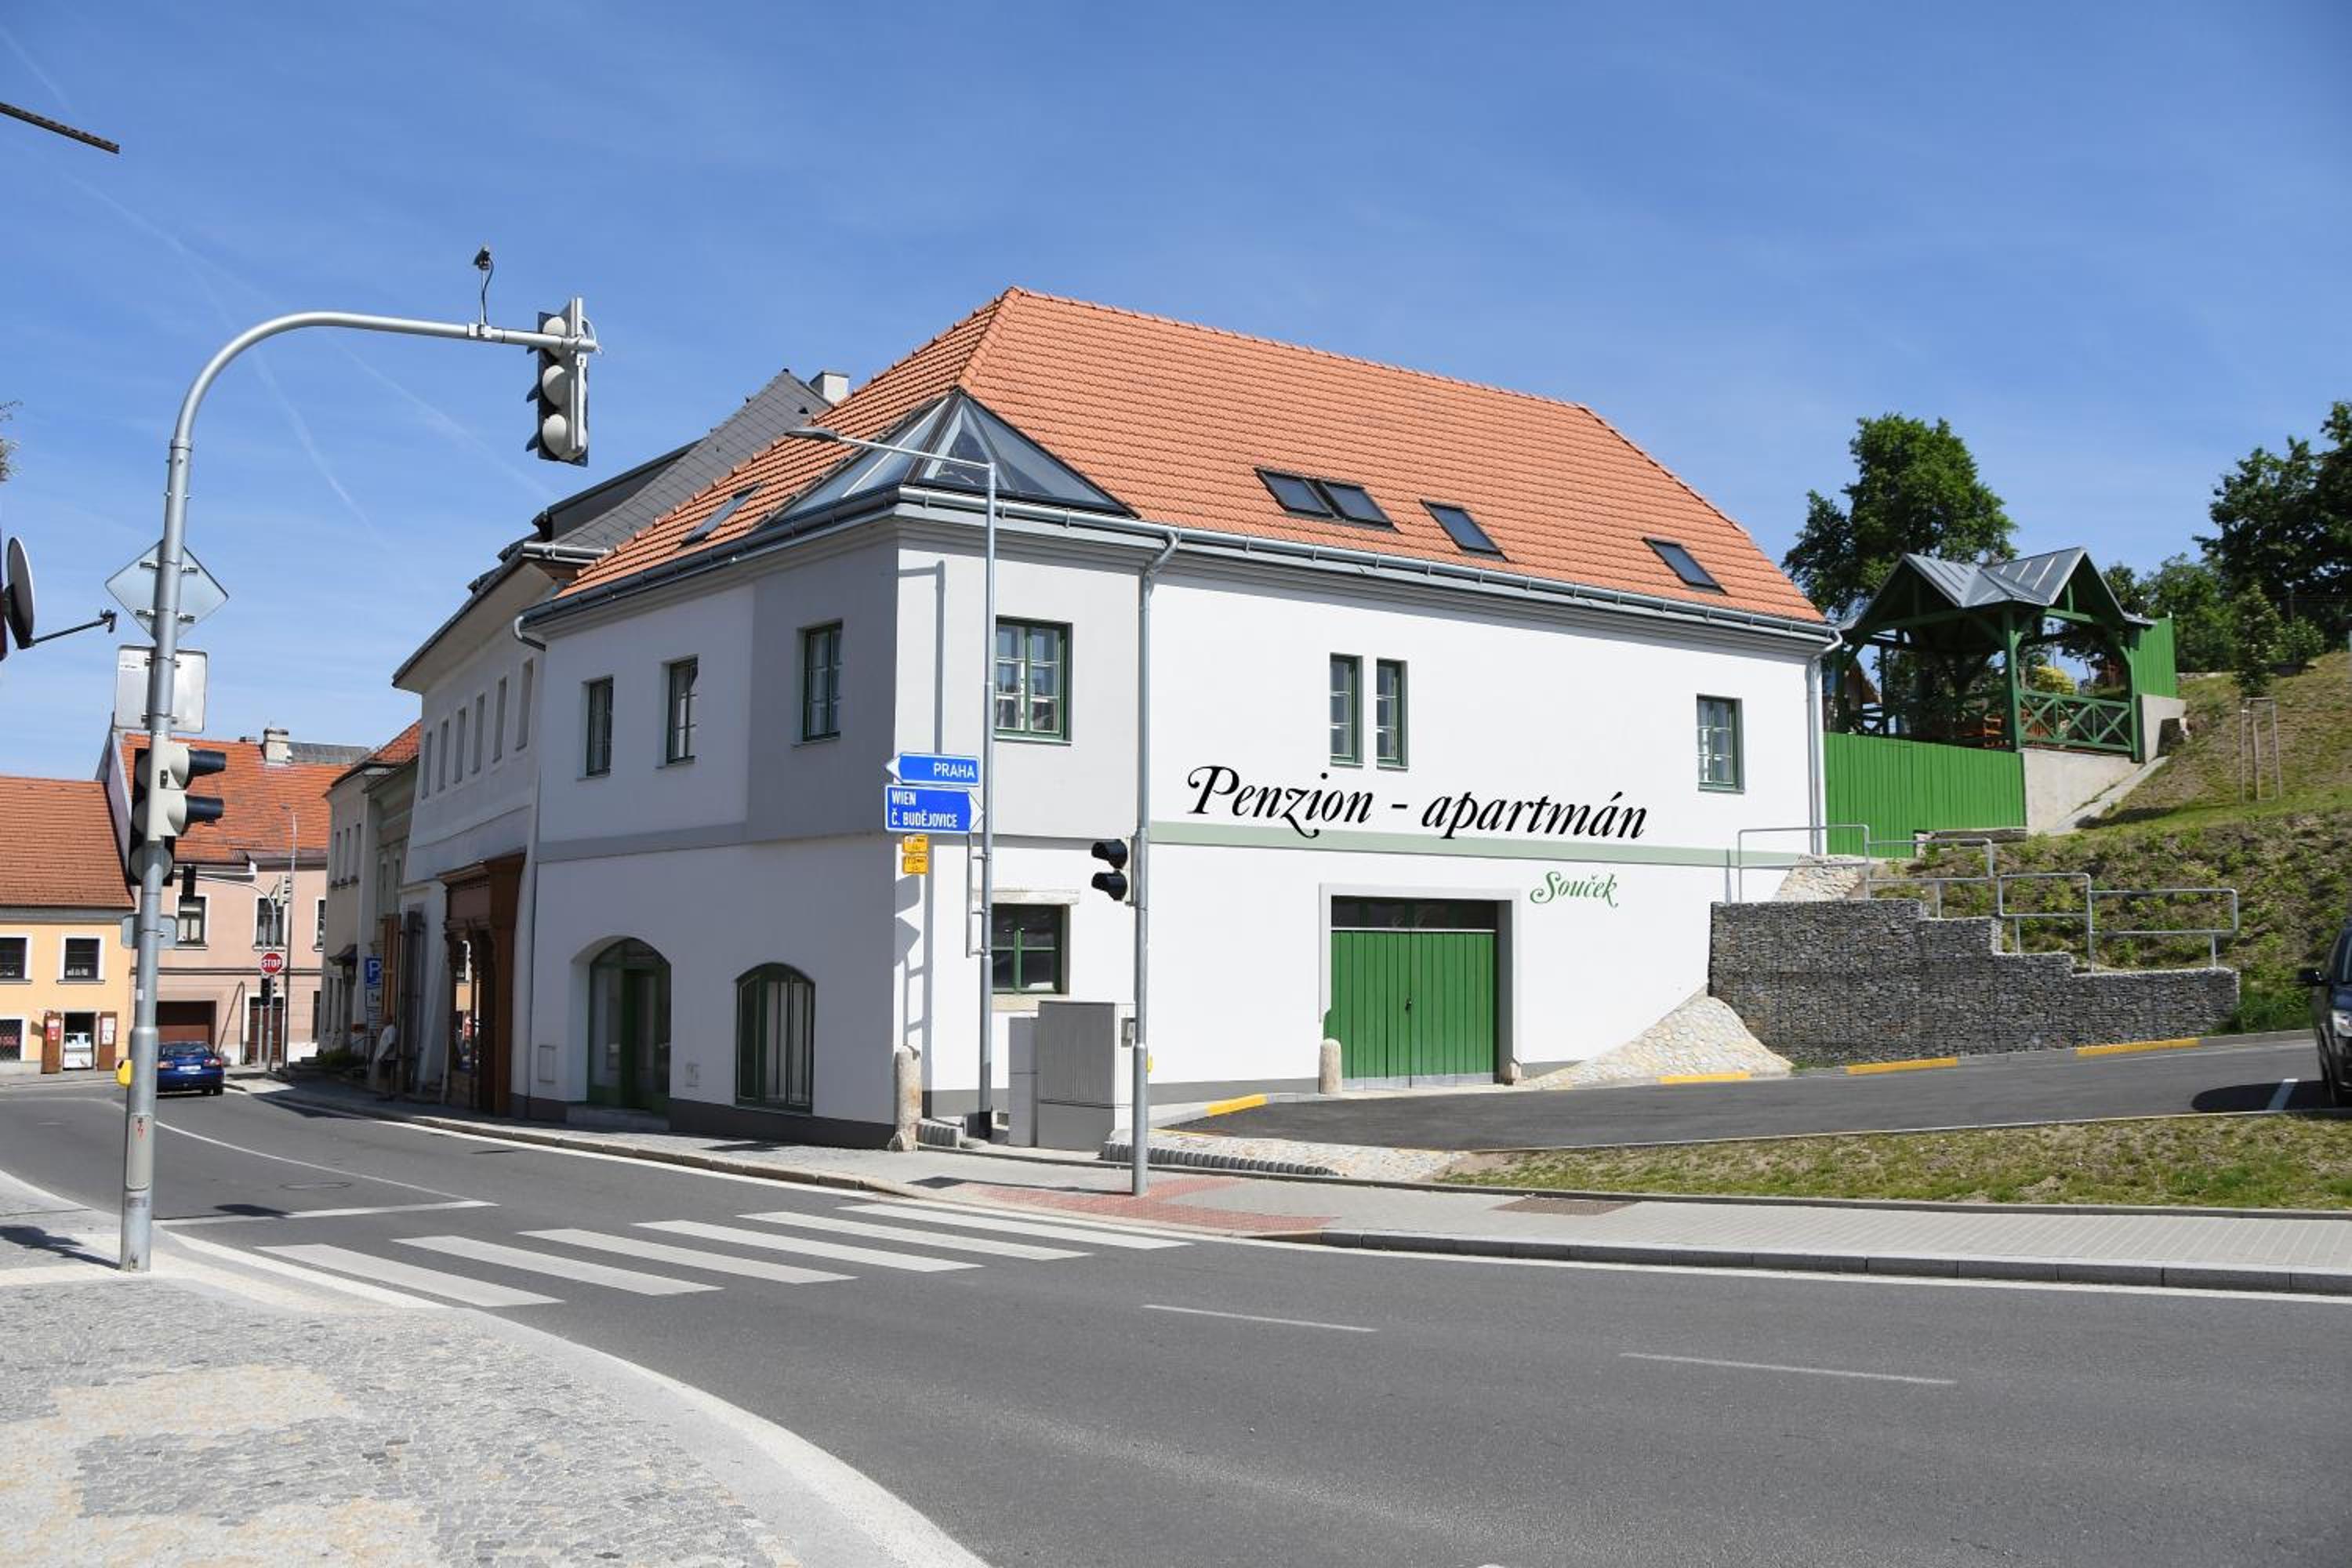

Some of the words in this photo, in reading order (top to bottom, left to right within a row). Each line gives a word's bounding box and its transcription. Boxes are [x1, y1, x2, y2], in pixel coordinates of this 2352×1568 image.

[933, 762, 975, 779] PRAHA
[891, 789, 917, 806] WIEN
[1187, 765, 1374, 840] Penzion
[1421, 791, 1648, 840] apartmán
[891, 808, 901, 826] Č.
[902, 809, 958, 829] BUDĚJOVICE
[1529, 871, 1619, 908] Souček
[262, 958, 281, 968] STOP
[368, 960, 382, 978] P
